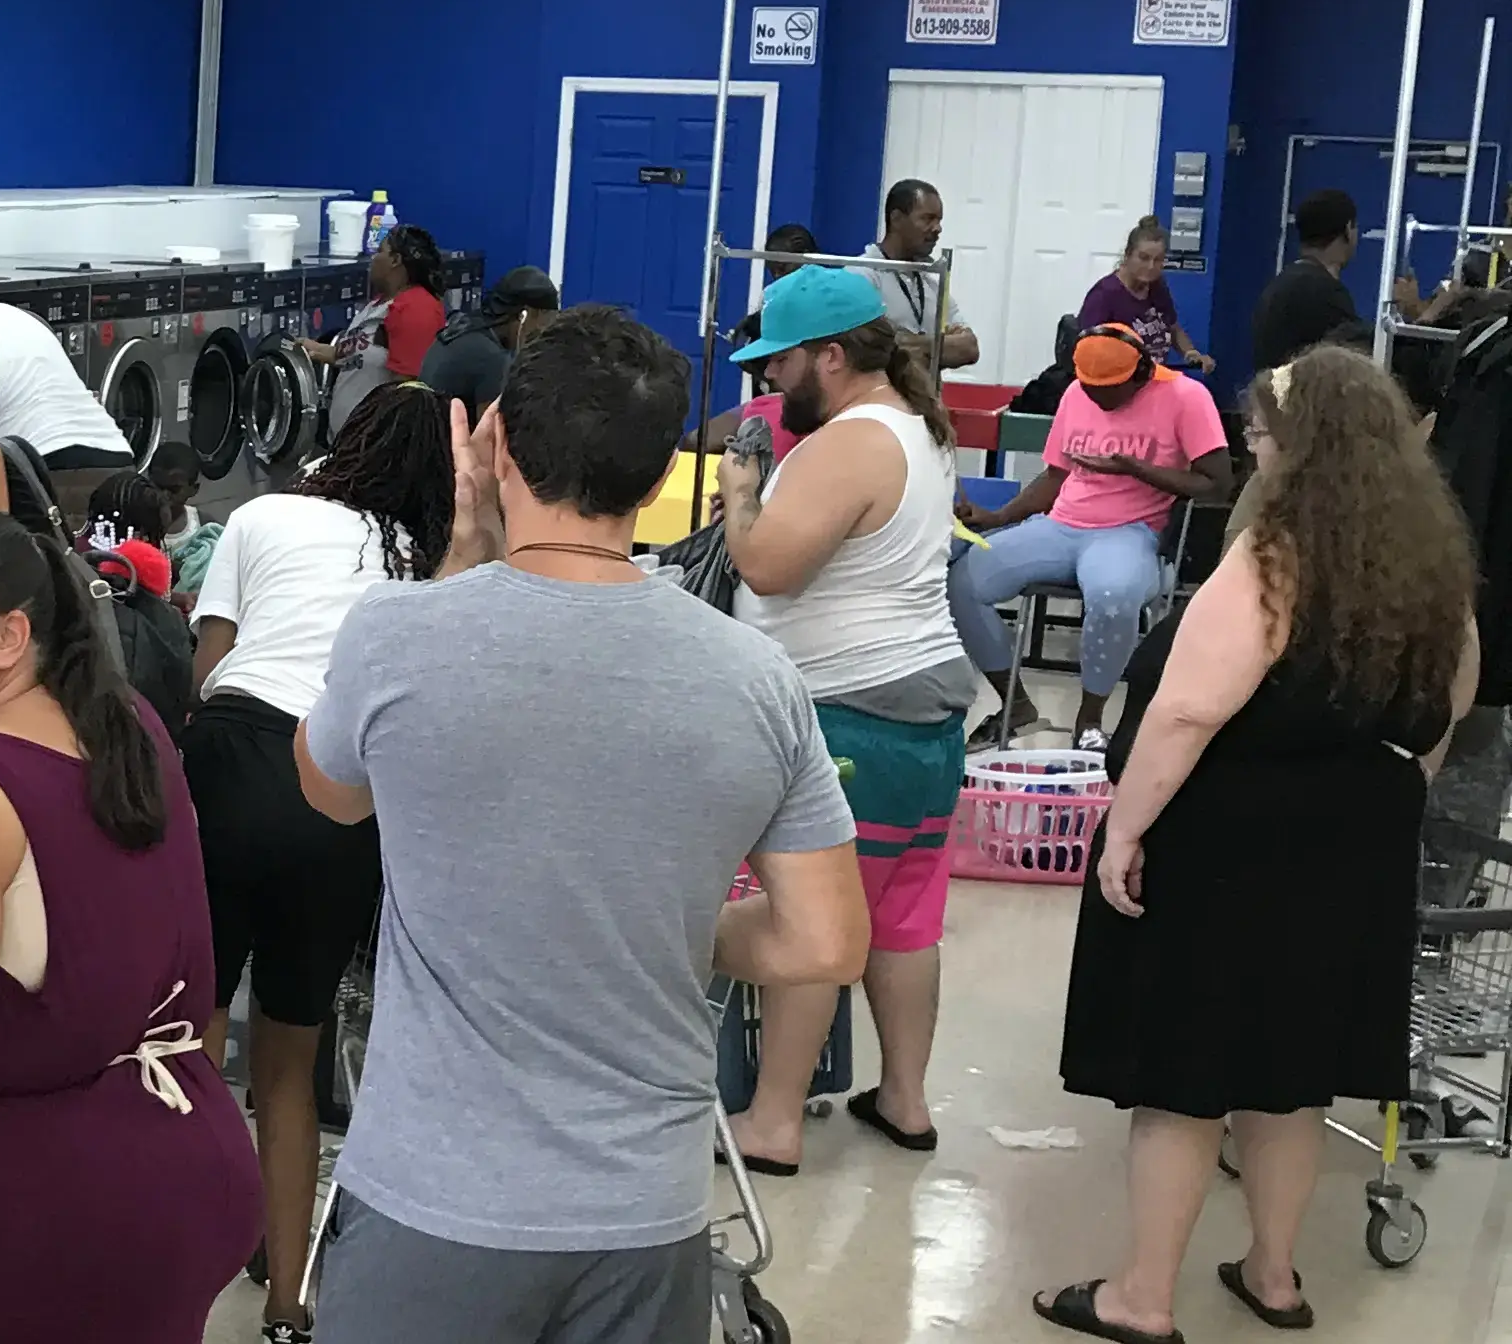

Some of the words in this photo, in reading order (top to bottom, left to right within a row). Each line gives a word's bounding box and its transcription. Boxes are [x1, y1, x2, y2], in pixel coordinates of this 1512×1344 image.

[755, 23, 776, 39] No
[914, 17, 991, 36] 813-909-5588
[755, 41, 812, 60] Smoking
